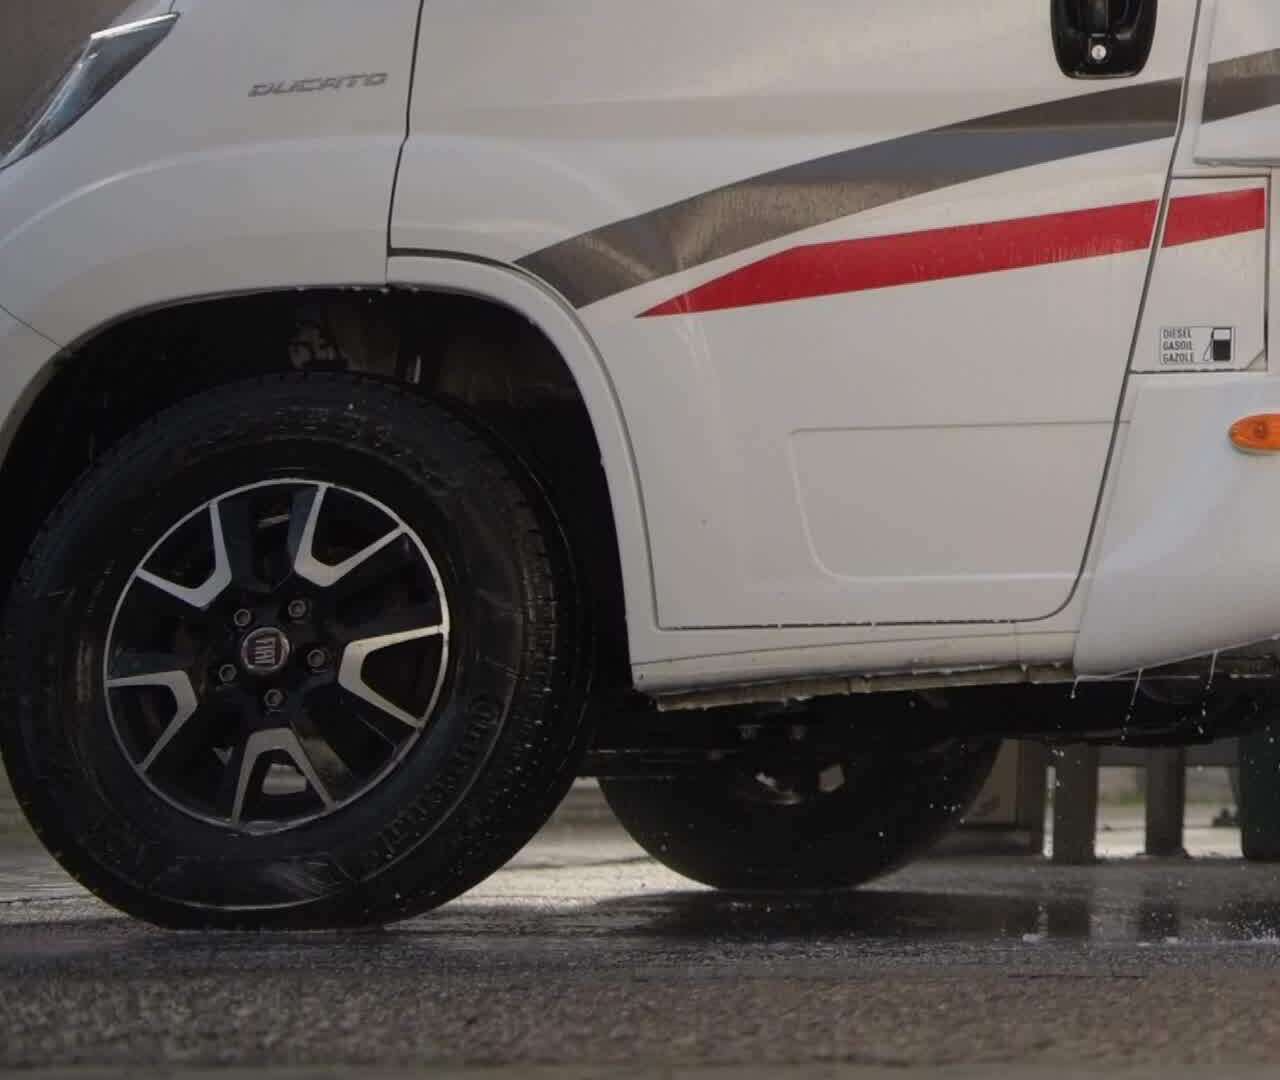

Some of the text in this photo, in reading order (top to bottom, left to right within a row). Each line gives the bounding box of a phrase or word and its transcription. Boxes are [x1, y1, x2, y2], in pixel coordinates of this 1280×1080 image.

[248, 72, 388, 97] DUCATO
[1162, 328, 1192, 339] DIESEL
[1162, 340, 1193, 351] GASOIL
[255, 636, 276, 665] FIAT
